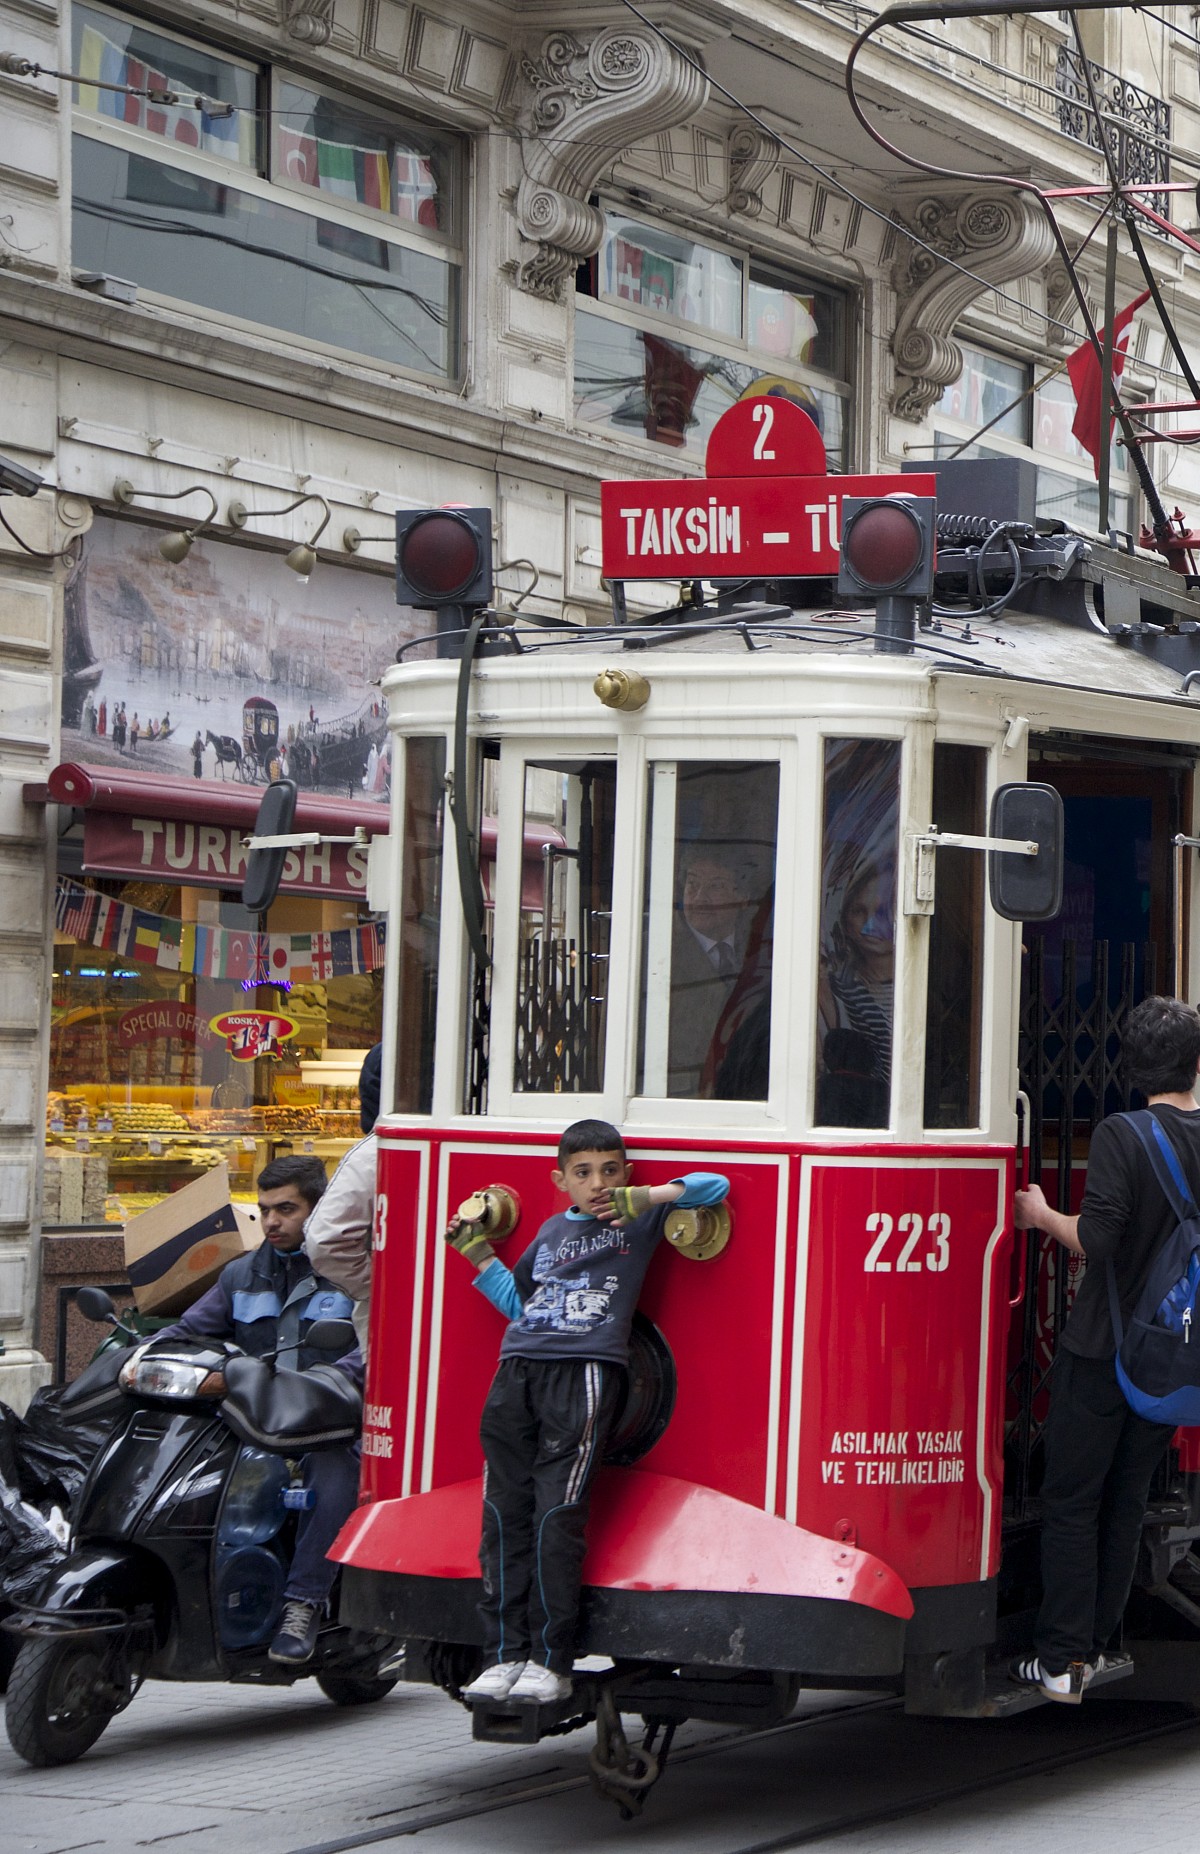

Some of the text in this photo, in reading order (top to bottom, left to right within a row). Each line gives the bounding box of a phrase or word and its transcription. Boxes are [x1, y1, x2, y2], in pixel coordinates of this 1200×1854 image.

[752, 404, 775, 460] 2
[620, 497, 741, 555] TAKSİM
[131, 818, 332, 884] TURKSH
[122, 1010, 211, 1041] SPECIAL OFFER
[227, 1016, 259, 1026] KOSKA
[371, 1194, 388, 1251] 3
[864, 1213, 951, 1272] 223
[831, 1430, 962, 1454] ASILMAK YASAK
[822, 1456, 965, 1485] VE TEHLİKELİDİR
